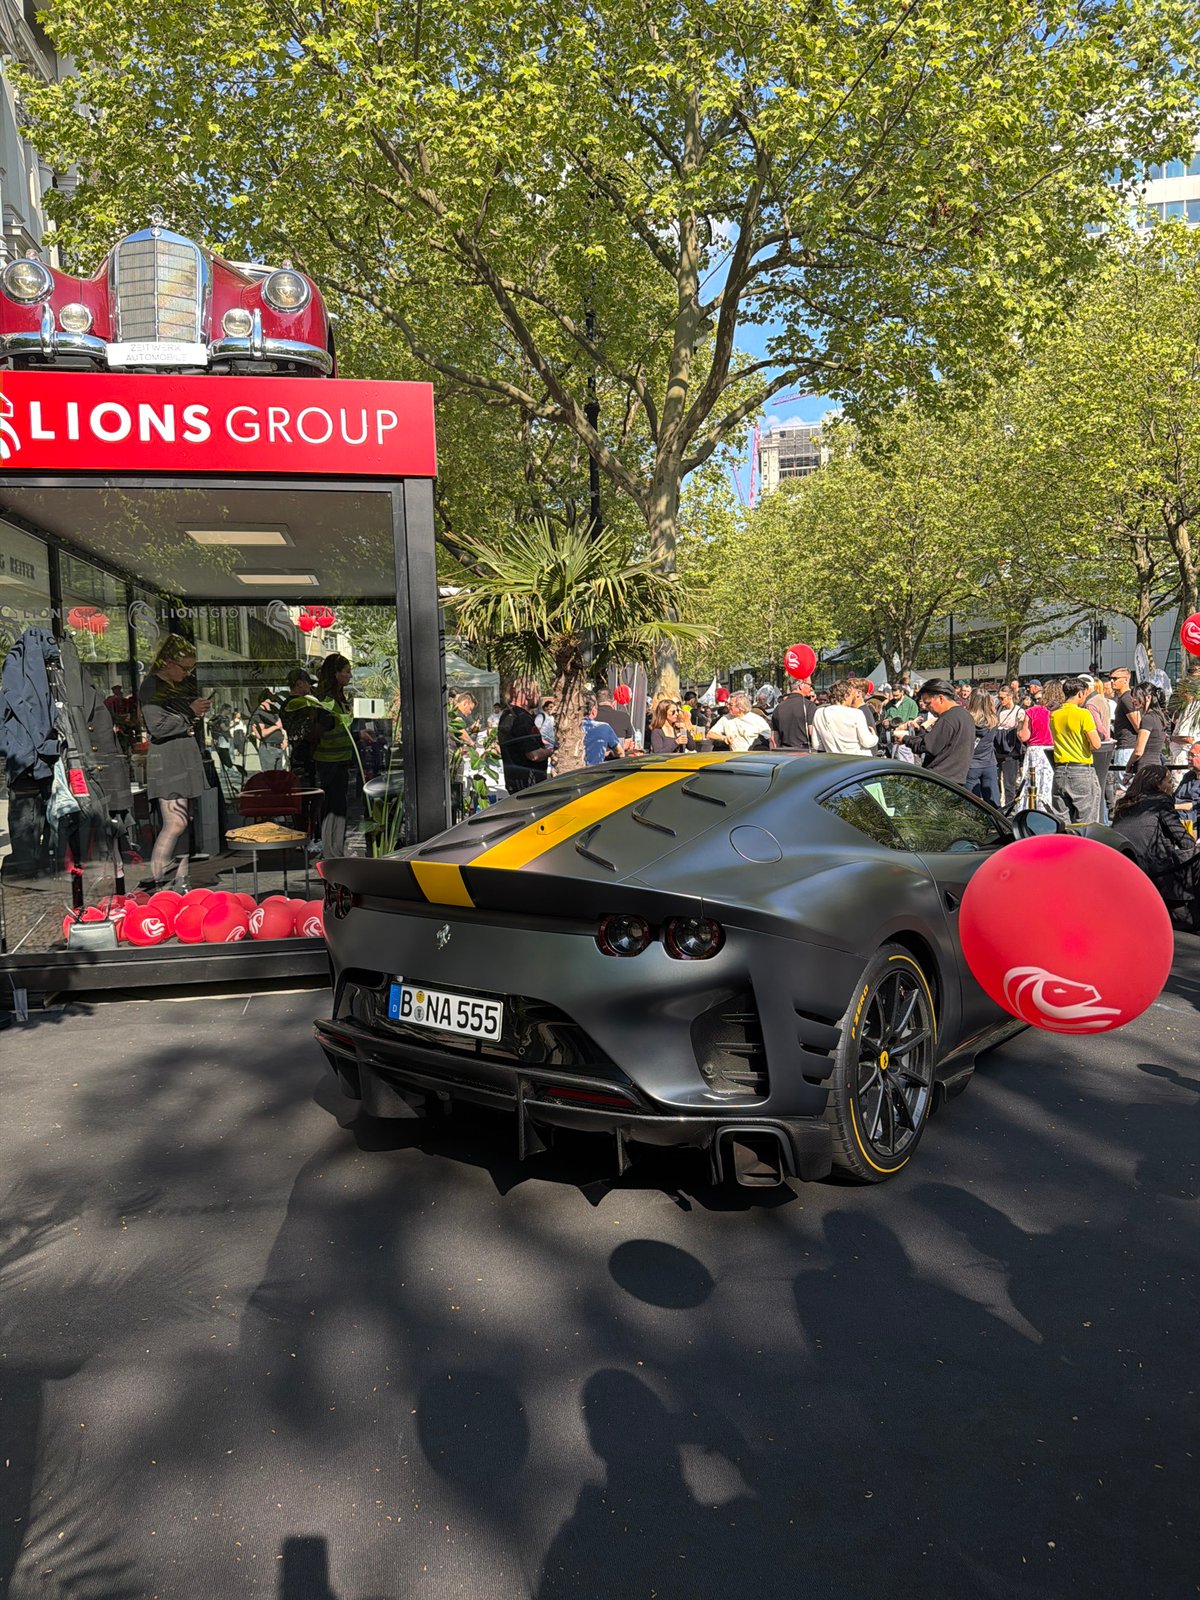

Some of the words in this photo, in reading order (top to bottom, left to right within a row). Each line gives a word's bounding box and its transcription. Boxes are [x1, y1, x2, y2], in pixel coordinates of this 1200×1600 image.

[130, 343, 181, 352] ZEITWERK
[125, 353, 188, 362] AUTOMOBILE
[29, 401, 212, 443] LIONS
[225, 404, 399, 445] GROUP
[161, 608, 208, 619] LIONS
[391, 1004, 398, 1013] D
[400, 989, 413, 1018] B
[425, 994, 452, 1026] NA
[456, 1000, 499, 1034] 555
